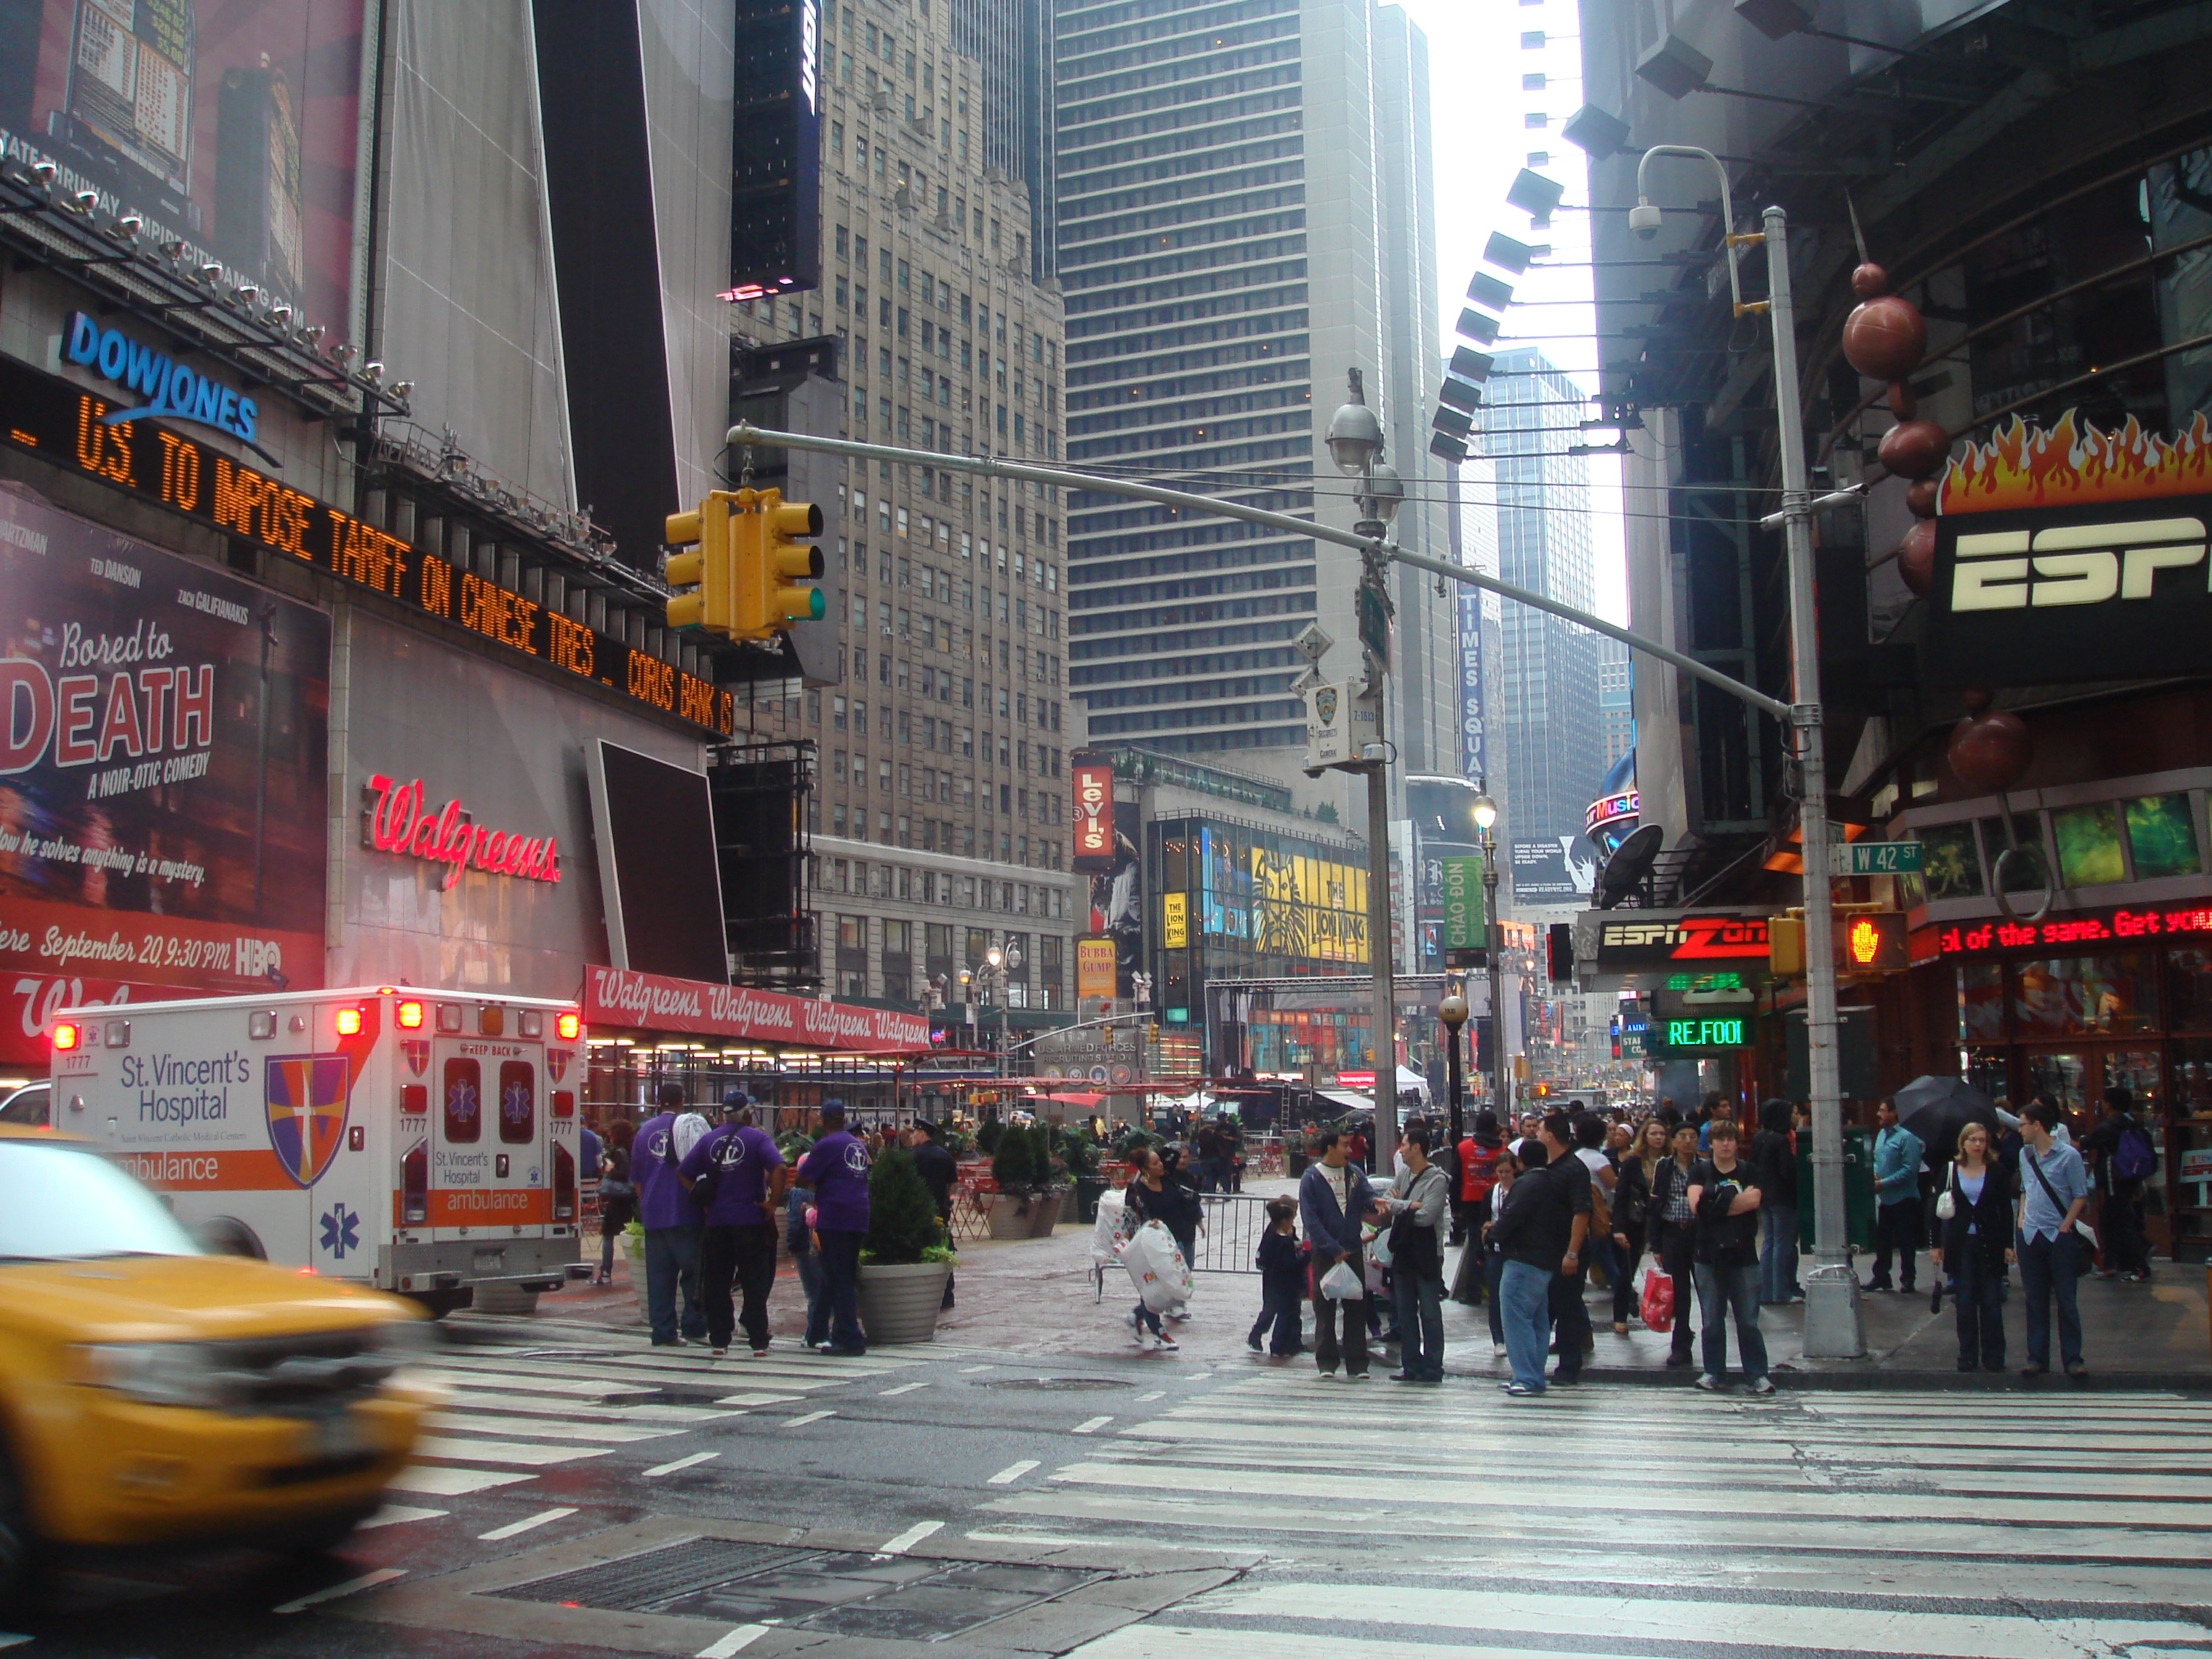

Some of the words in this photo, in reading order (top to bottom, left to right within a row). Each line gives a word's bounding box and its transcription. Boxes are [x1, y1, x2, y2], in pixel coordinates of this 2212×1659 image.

[91, 557, 104, 575] TED
[104, 559, 141, 589] DANSON
[1951, 517, 2212, 613] ESP
[158, 431, 199, 511] TO
[421, 554, 451, 618] ON
[680, 673, 715, 728] BANK
[195, 591, 248, 625] GALIFIANAKIS
[60, 619, 143, 668] Bored
[147, 621, 174, 660] to
[1460, 594, 1479, 686] TIMES
[0, 657, 214, 775] DEATH
[87, 773, 97, 800] A
[99, 760, 162, 799] NOIR-OTIC
[163, 751, 210, 785] COMEDY
[369, 774, 561, 890] Walgreens
[20, 830, 40, 856] he
[40, 835, 81, 863] solves
[81, 845, 135, 878] anything
[136, 850, 148, 873] is
[148, 857, 157, 876] a
[158, 858, 205, 889] mystery.
[1858, 848, 1871, 871] W
[1876, 846, 1897, 871] 42
[1904, 846, 1917, 859] ST
[1327, 880, 1344, 901] THE
[1169, 902, 1182, 912] THE
[1166, 914, 1184, 927] LION
[1966, 923, 1993, 950] of
[1997, 922, 2037, 947] the
[2042, 919, 2110, 944] game.
[2114, 910, 2160, 937] Get
[1166, 927, 1184, 941] KING
[1604, 924, 1688, 947] ESPN
[40, 925, 137, 966] September
[163, 935, 203, 968] 9:30
[202, 940, 231, 971] PM
[235, 938, 282, 976] HBO
[1080, 945, 1114, 958] BUBBA
[1082, 961, 1112, 973] GUMP
[595, 968, 703, 1025] Walgreens
[708, 985, 793, 1036] Walgreens
[804, 1000, 872, 1045] Walgreens
[875, 1010, 930, 1047] Walgreens
[469, 1045, 488, 1056] KEEP
[492, 1046, 511, 1057] BACK
[1044, 1053, 1094, 1064] RECRUITING
[1056, 1043, 1094, 1053] ARMED
[1094, 1043, 1136, 1053] FORCES
[66, 1055, 91, 1069] 1777
[121, 1055, 149, 1088] St.
[152, 1050, 250, 1087] Vincent's
[140, 1087, 227, 1128] Hospital
[193, 1132, 219, 1141] Medical
[400, 1118, 427, 1133] 1777
[549, 1121, 573, 1135] 1777
[116, 1152, 219, 1181] mbulance
[436, 1151, 449, 1166] St.
[449, 1151, 488, 1167] Vincent's
[444, 1169, 480, 1186] Hospital
[447, 1190, 528, 1210] ambulance
